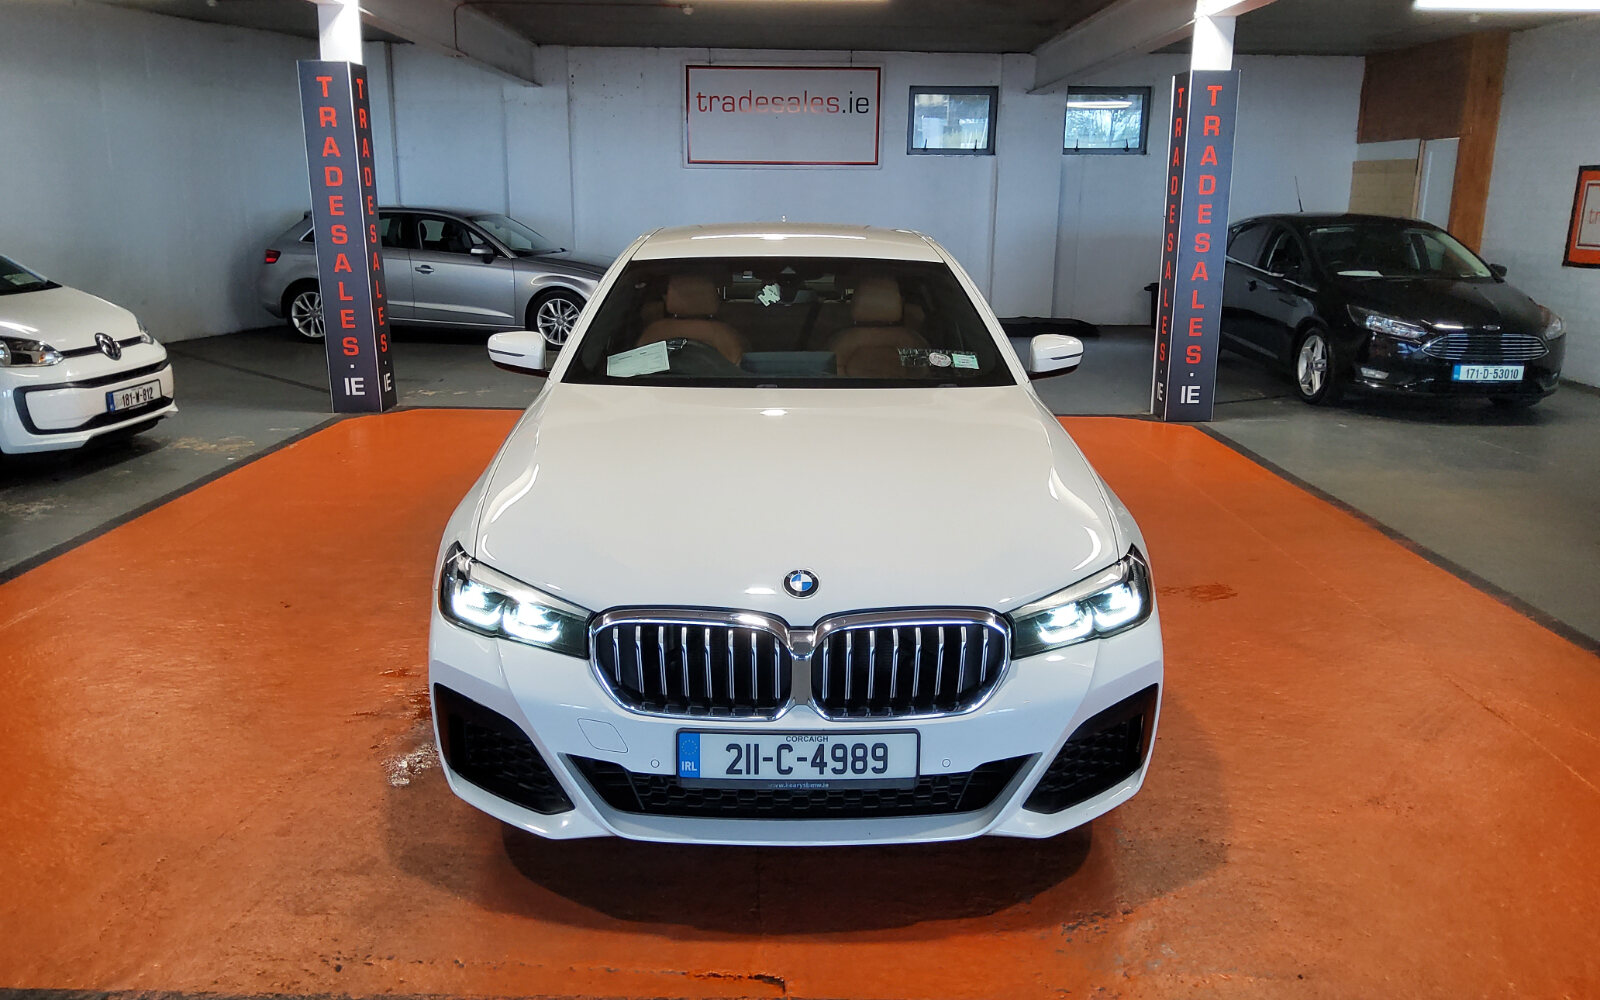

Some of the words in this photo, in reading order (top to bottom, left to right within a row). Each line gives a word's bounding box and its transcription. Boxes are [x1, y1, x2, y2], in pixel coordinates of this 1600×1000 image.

[696, 90, 869, 114] tradesales.ie
[1466, 368, 1519, 379] 171-D-53010
[785, 735, 829, 743] CORCAIGH
[725, 743, 888, 775] 211-C-4989
[681, 761, 697, 772] IRL
